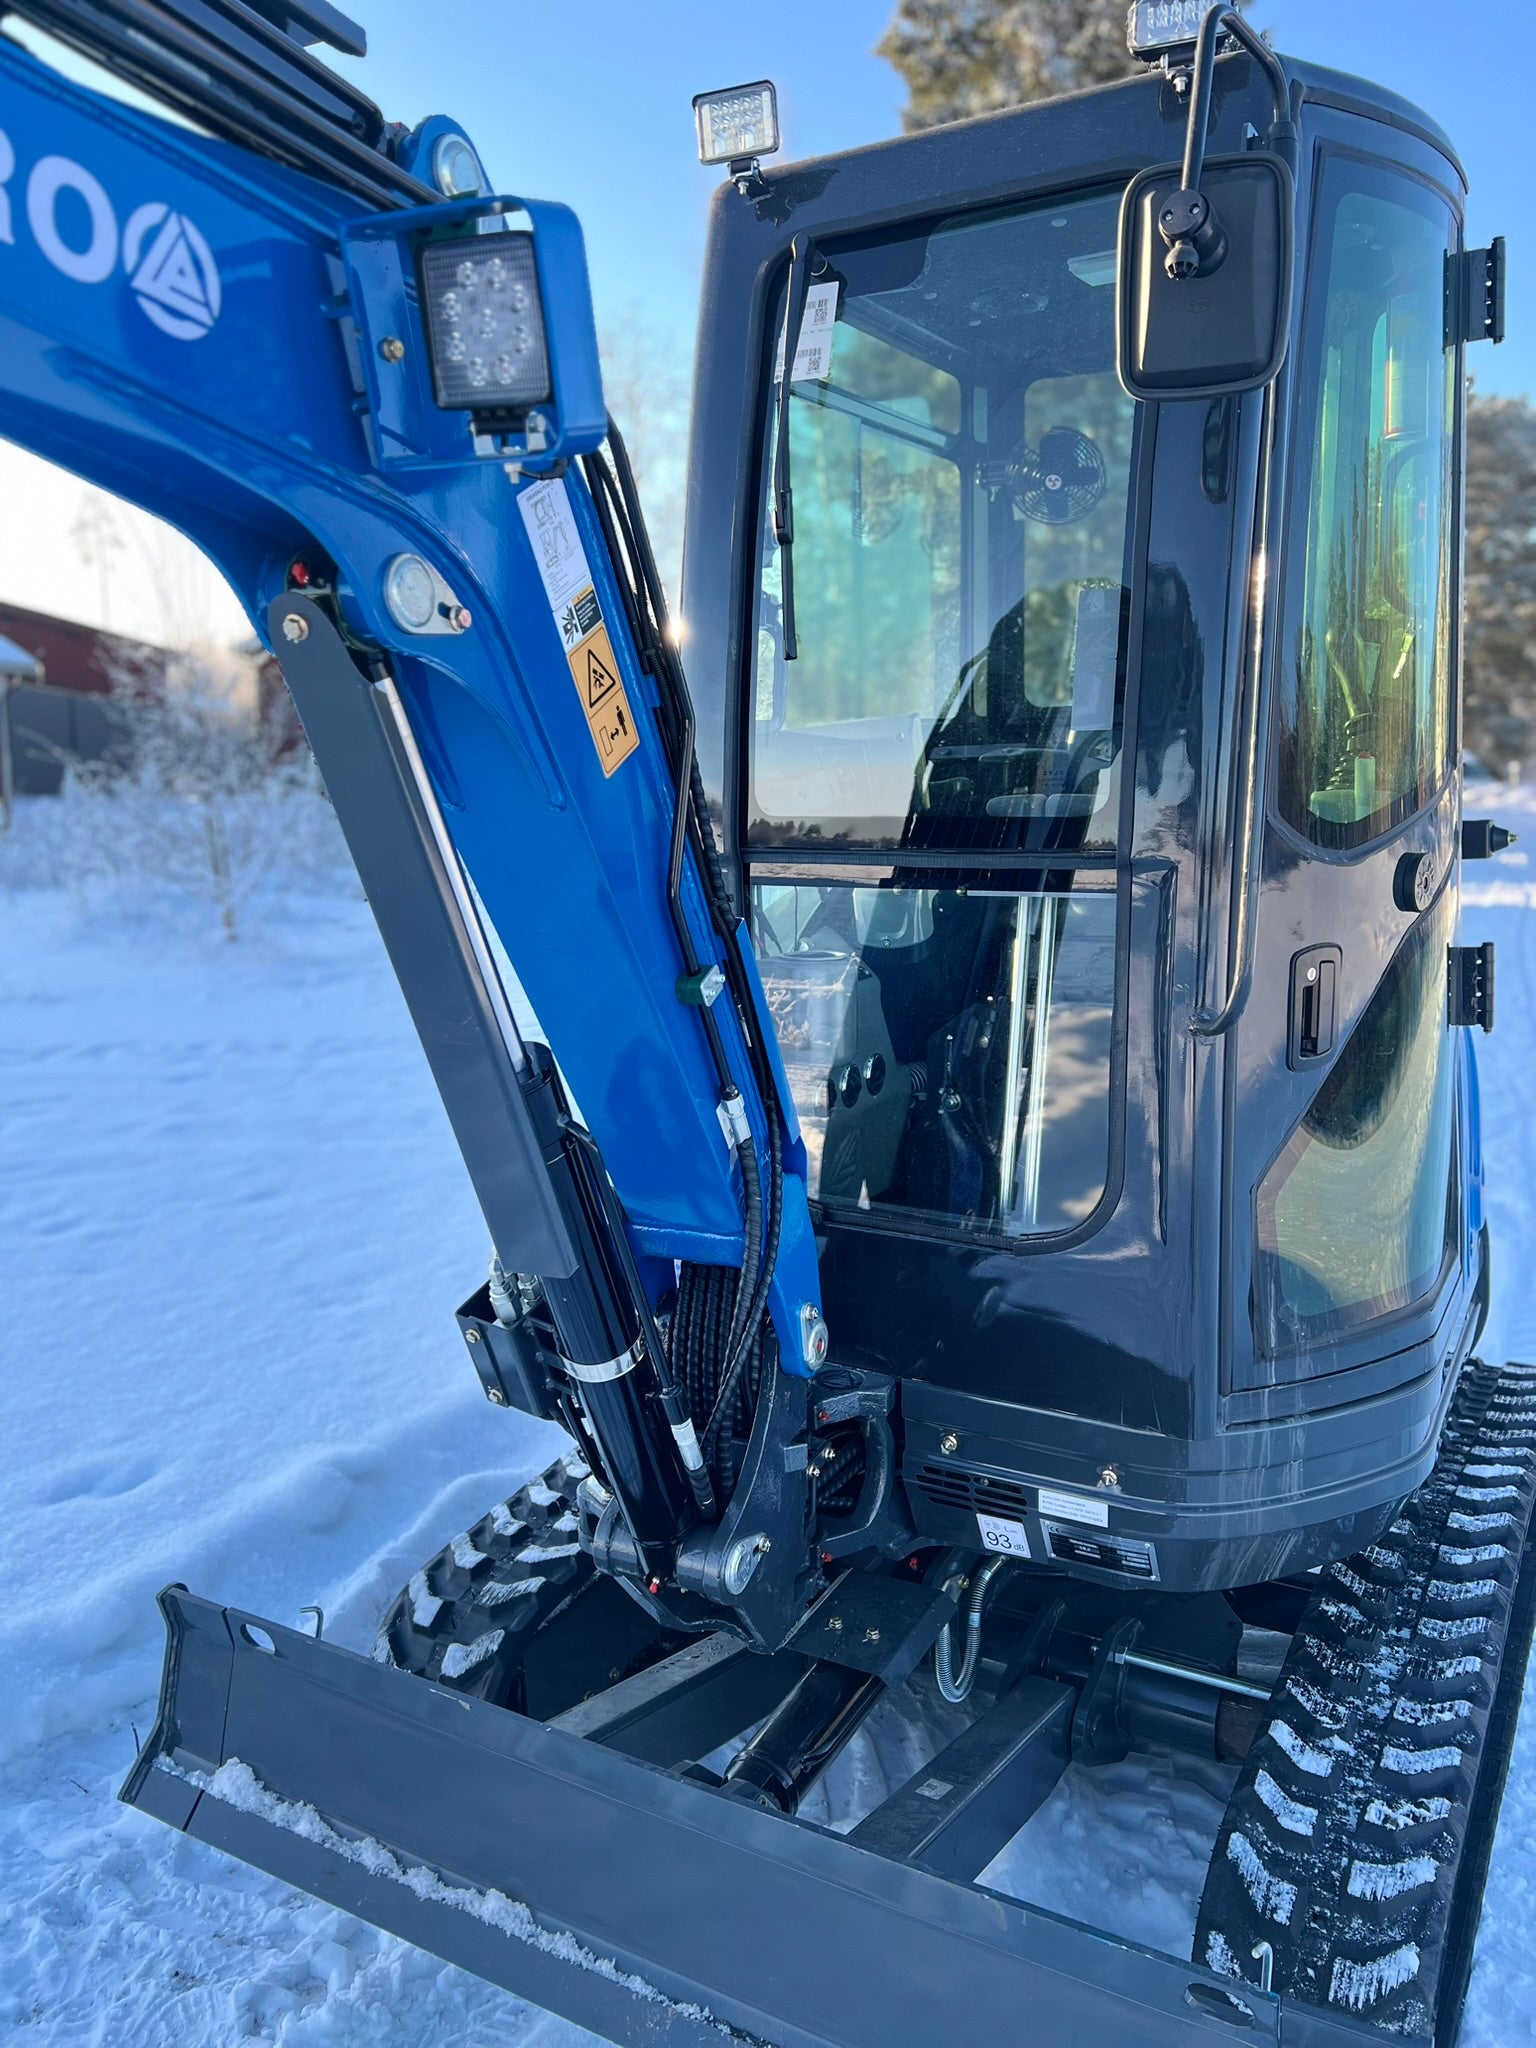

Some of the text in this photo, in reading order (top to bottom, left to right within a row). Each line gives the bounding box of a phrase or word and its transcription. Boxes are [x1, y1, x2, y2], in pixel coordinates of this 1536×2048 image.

[0, 127, 119, 285] O
[986, 1531, 1025, 1552] 93 dB
